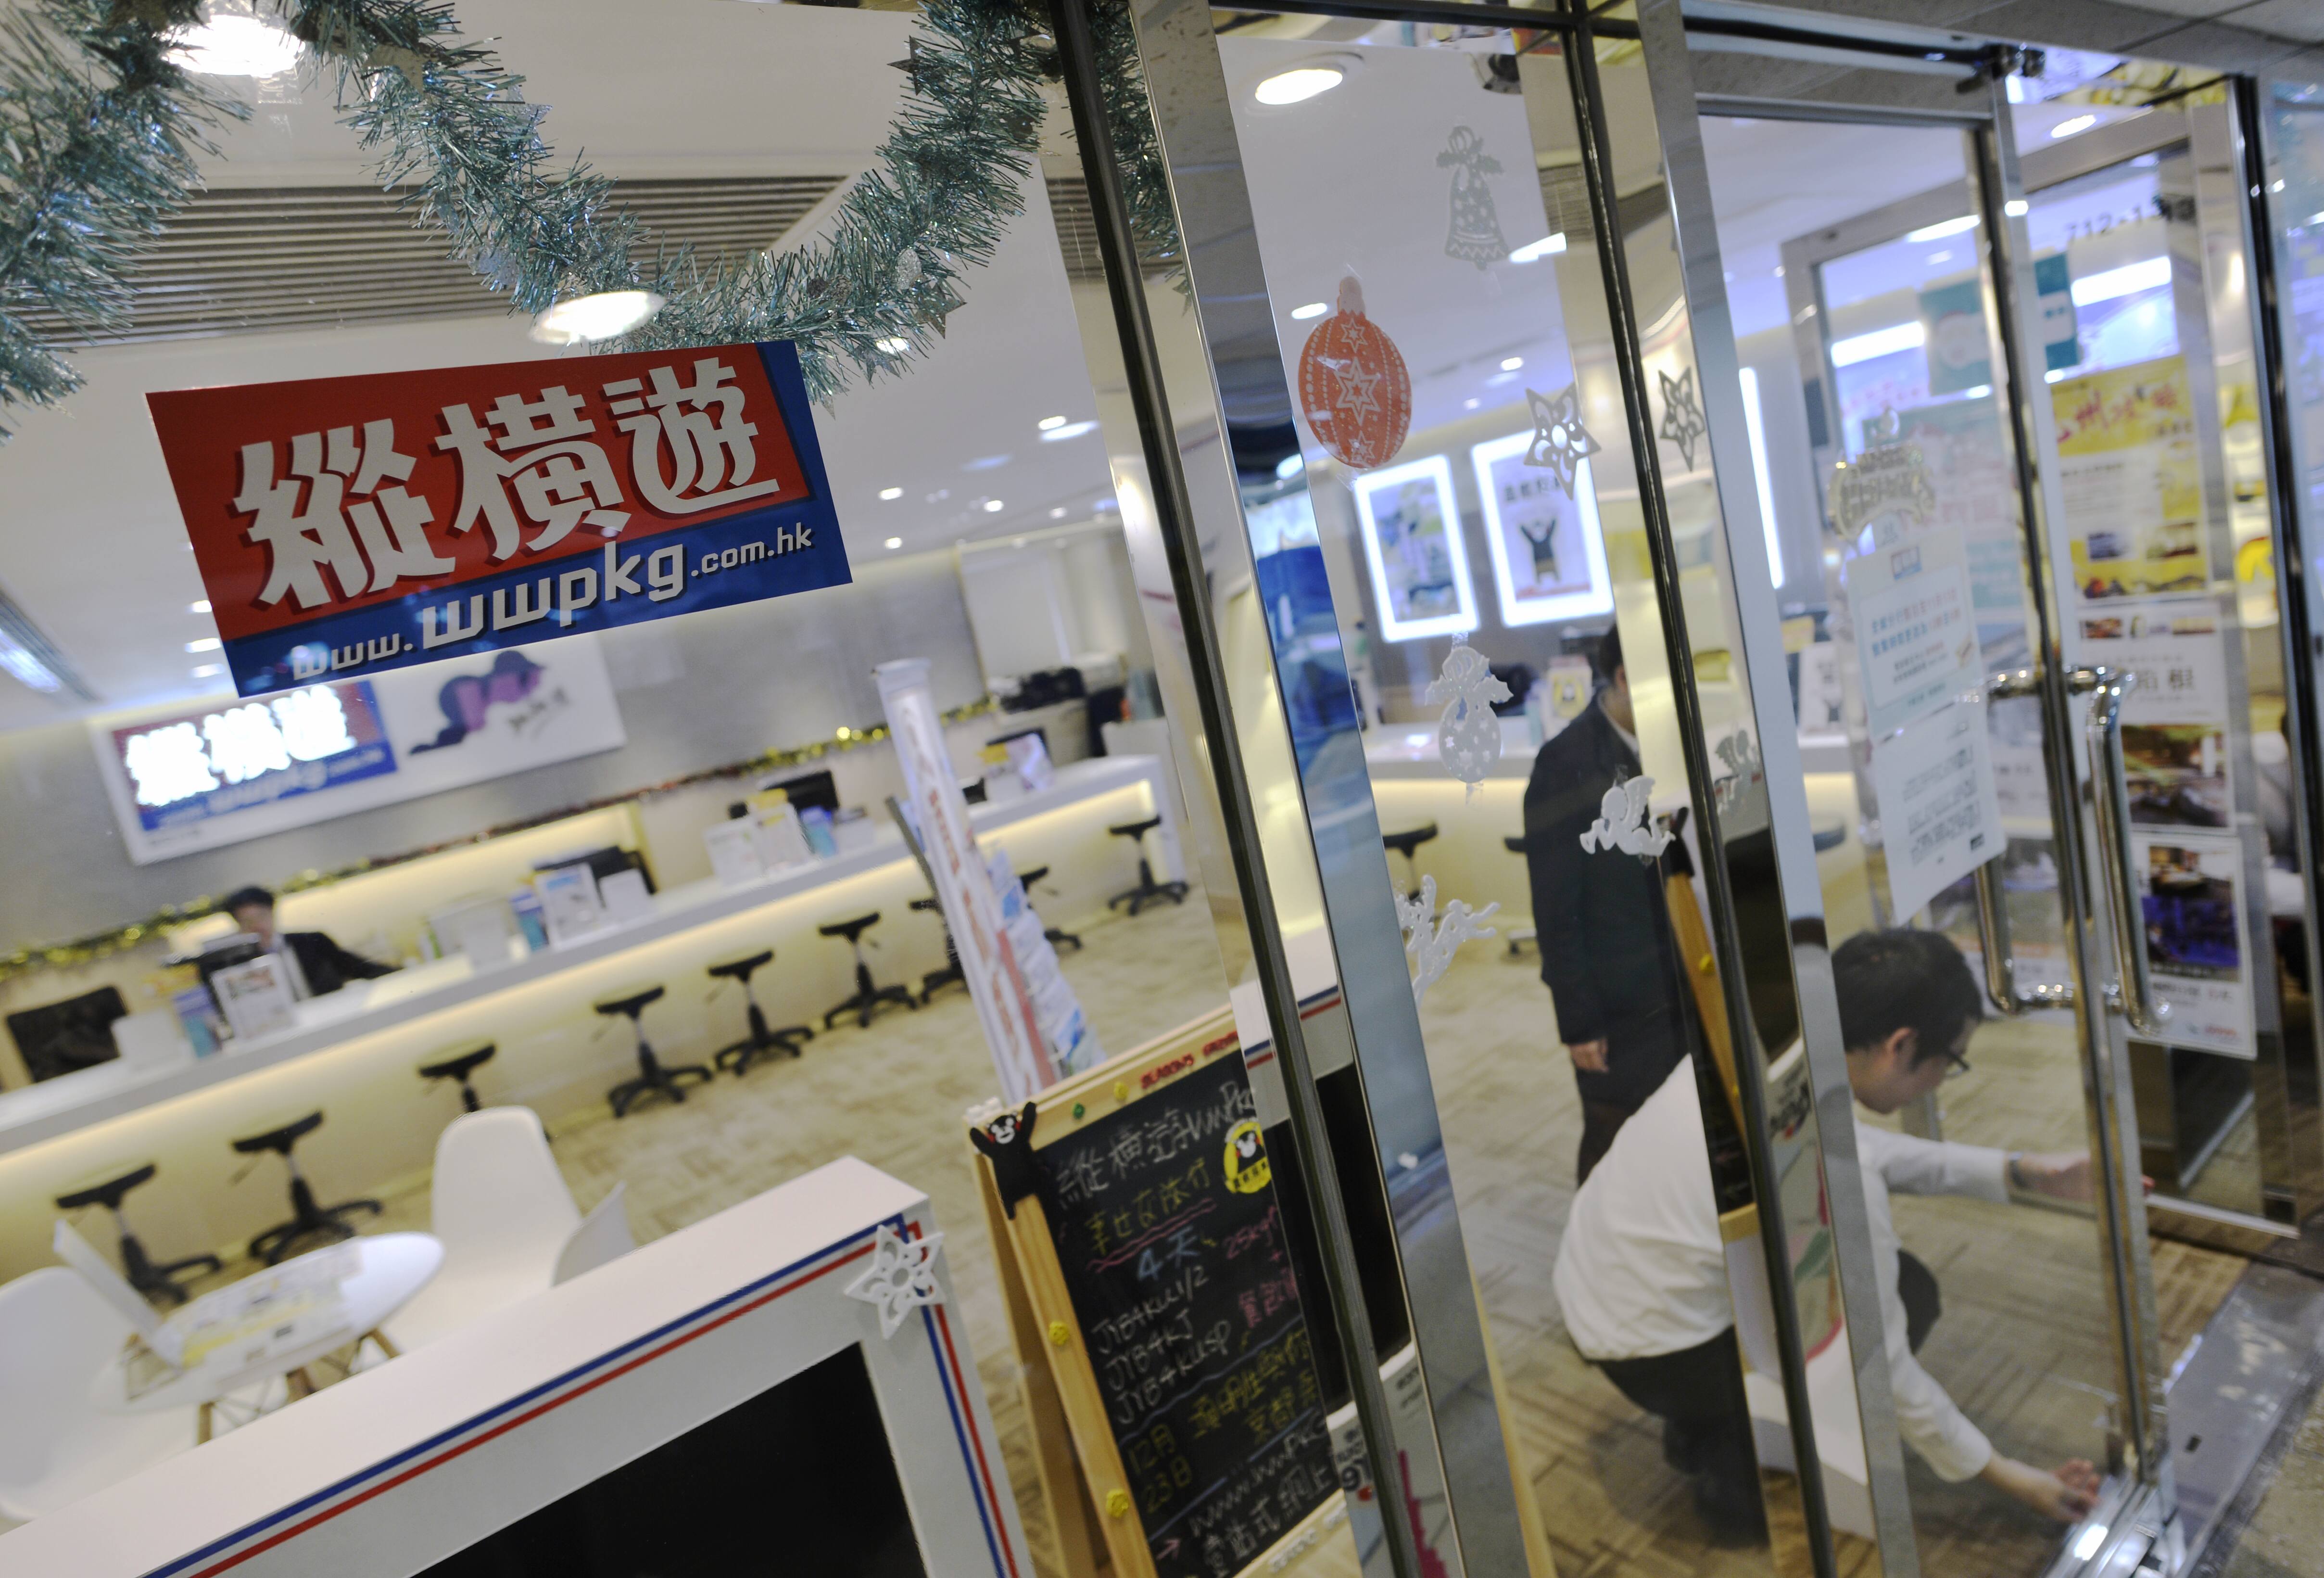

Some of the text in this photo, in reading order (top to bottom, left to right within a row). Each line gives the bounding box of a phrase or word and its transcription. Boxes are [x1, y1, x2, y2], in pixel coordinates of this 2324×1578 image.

[233, 357, 780, 609] 縱橫遊
[293, 522, 812, 680] www.wwpkg.com.hk
